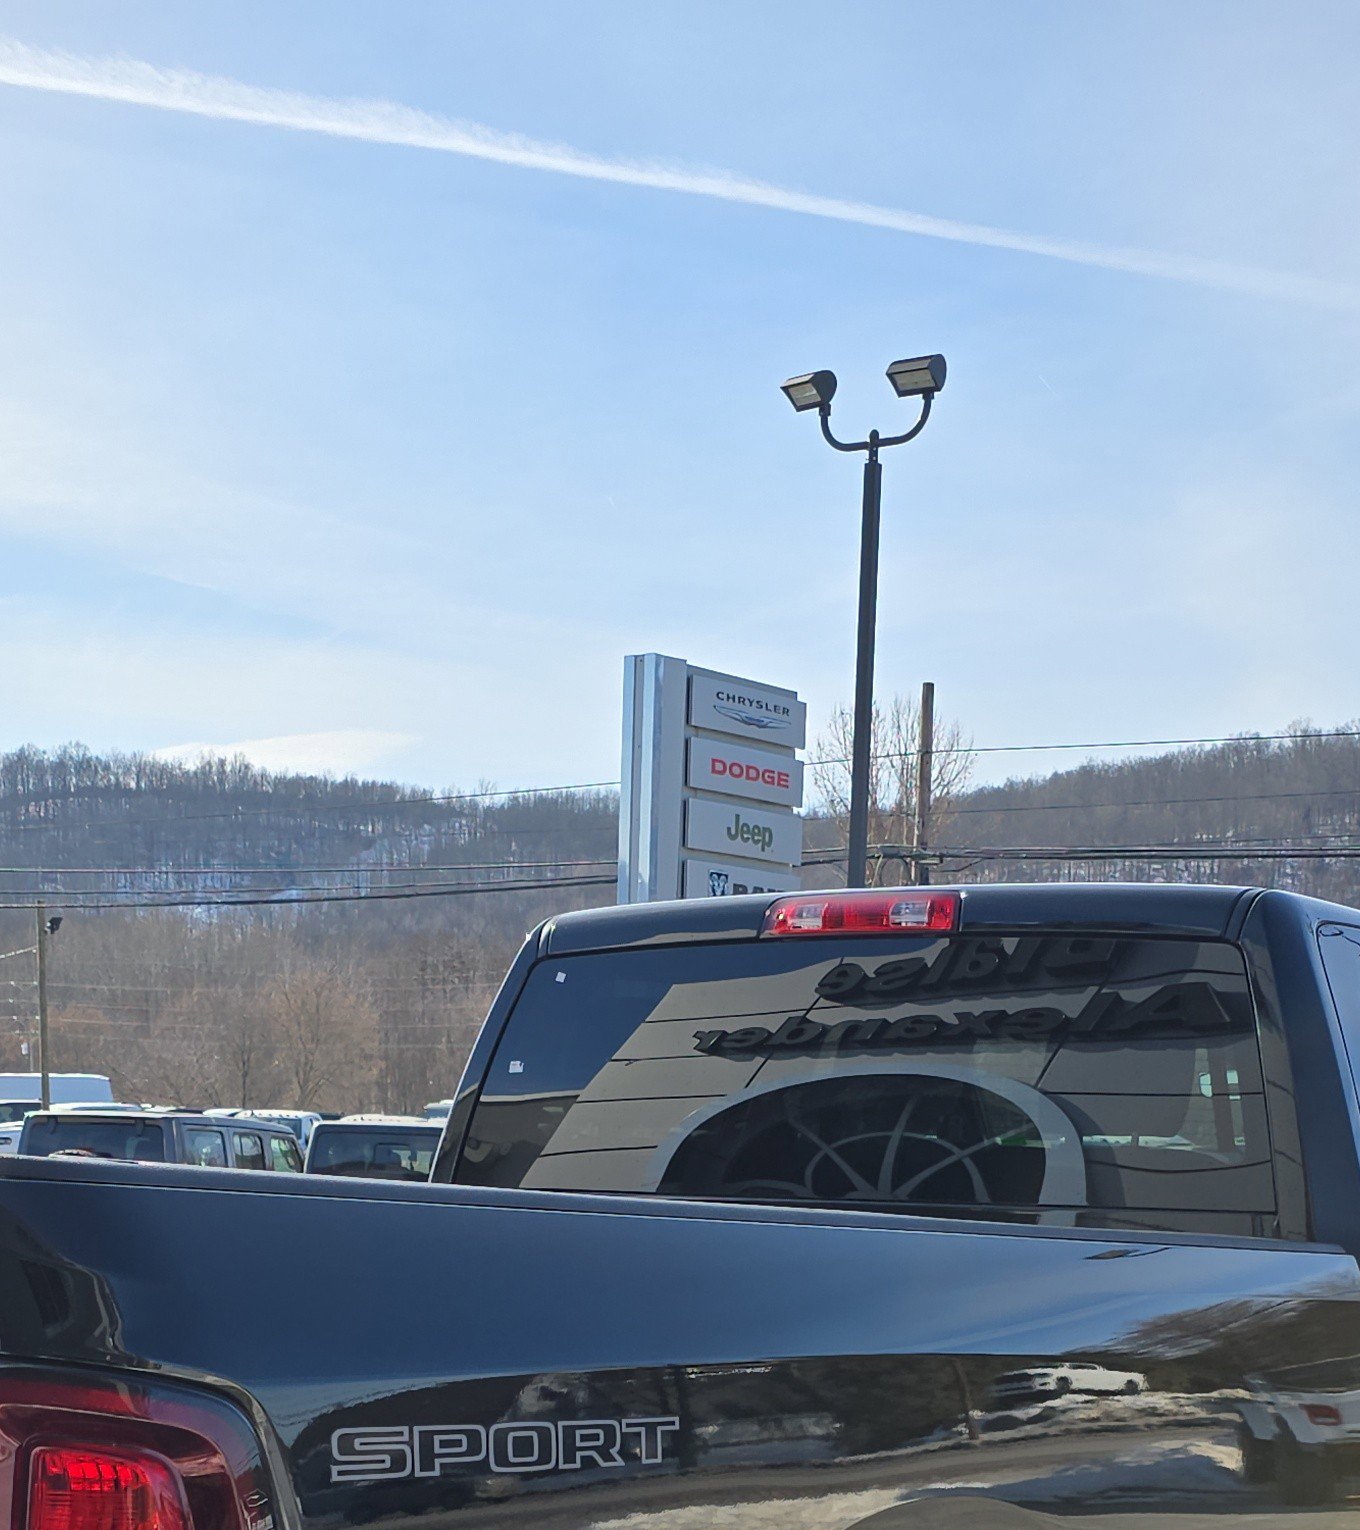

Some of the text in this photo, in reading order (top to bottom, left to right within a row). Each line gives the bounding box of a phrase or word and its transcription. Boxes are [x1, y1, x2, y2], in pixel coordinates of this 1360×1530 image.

[716, 691, 790, 717] CHRYSLER
[710, 757, 790, 789] DODGE
[726, 813, 773, 852] Jeep
[330, 1416, 680, 1482] SPORT
